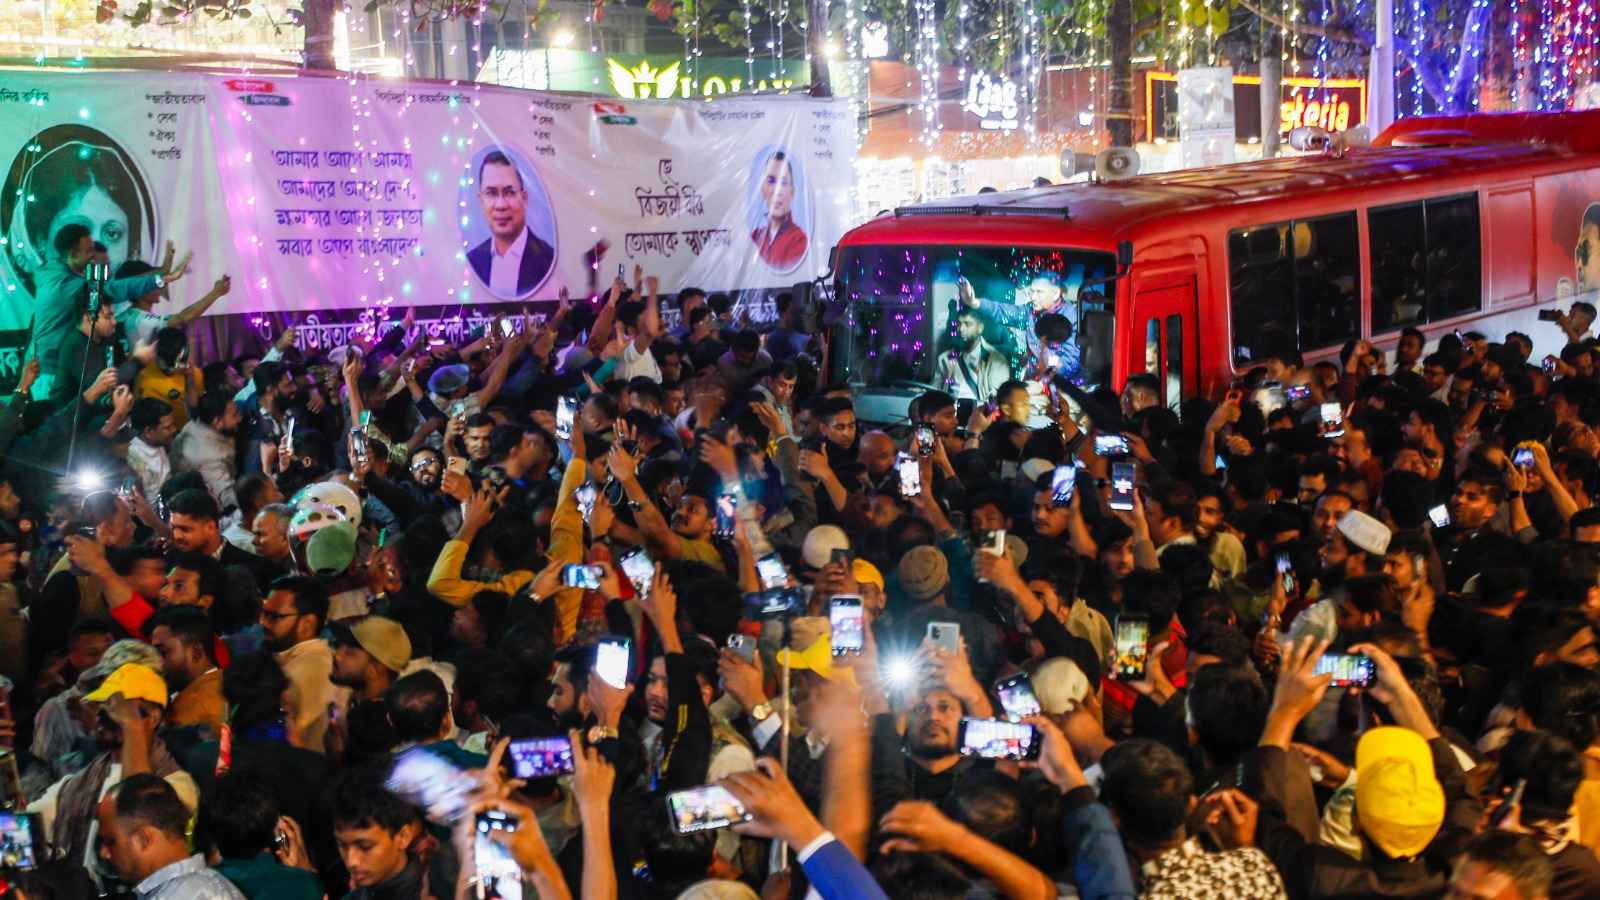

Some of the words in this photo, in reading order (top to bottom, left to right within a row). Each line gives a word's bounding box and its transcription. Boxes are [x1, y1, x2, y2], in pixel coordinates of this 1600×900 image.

[272, 150, 319, 169] আমার
[277, 179, 336, 201] আমাদের
[634, 185, 680, 218] বিজয়ী
[276, 238, 313, 257] সবার
[625, 231, 679, 260] তোমাকে
